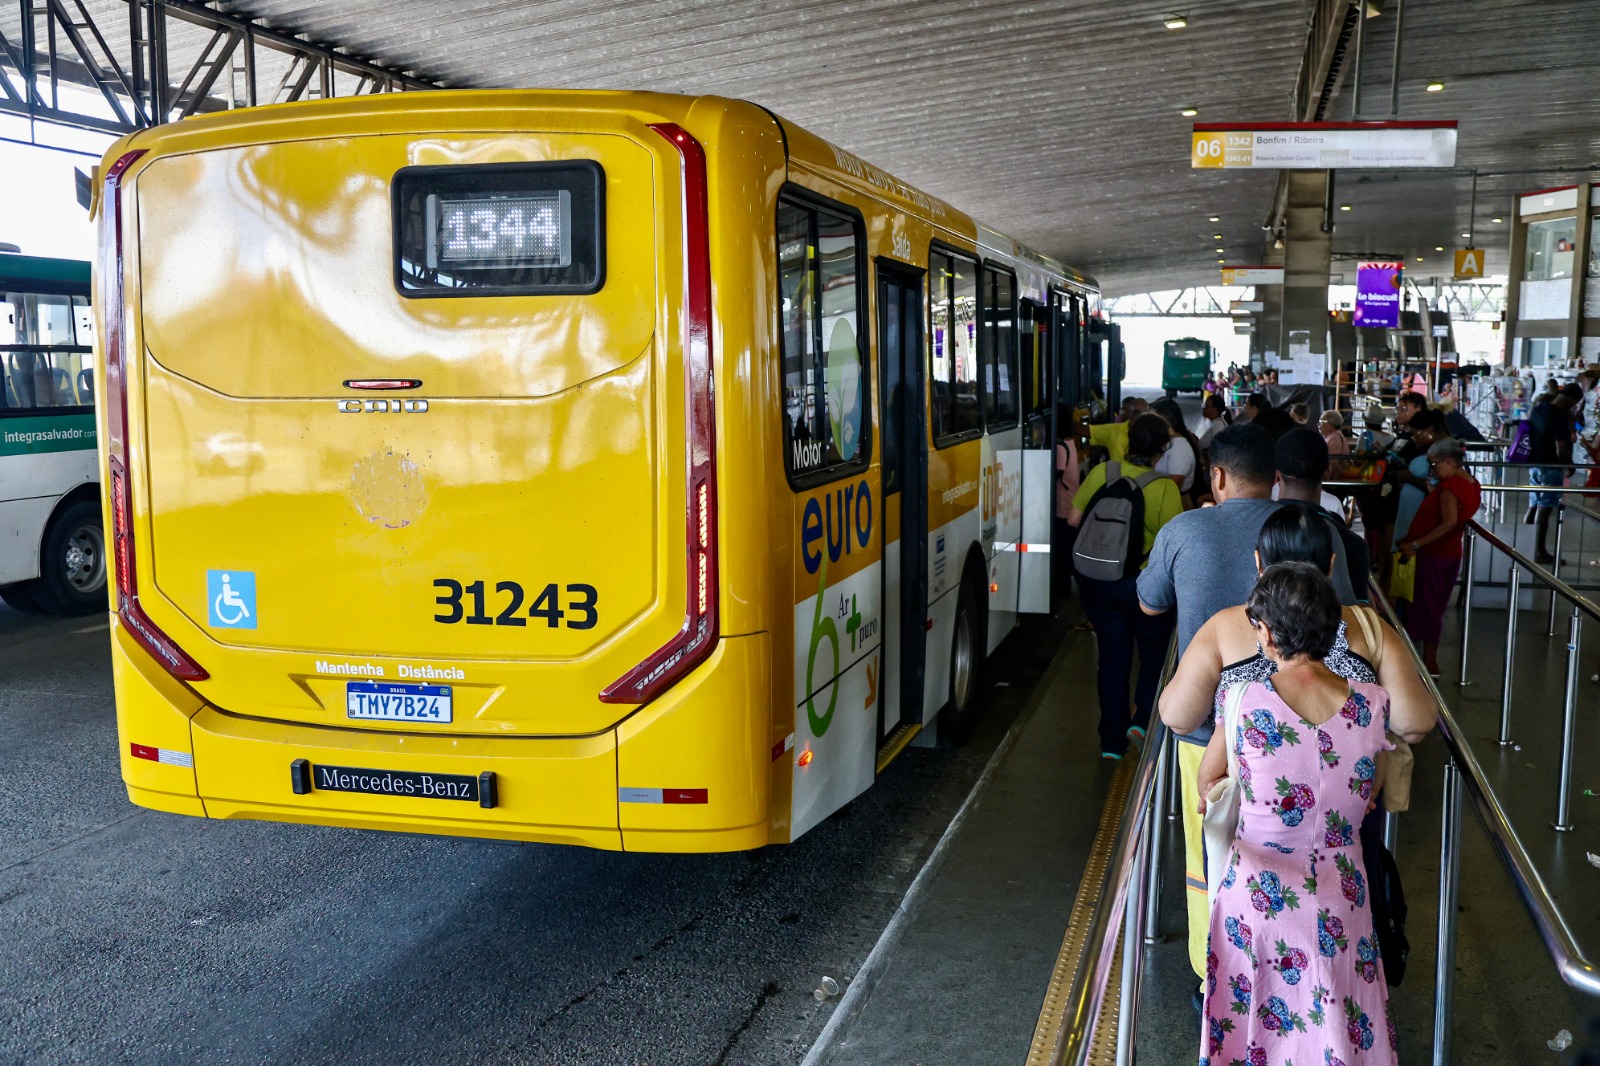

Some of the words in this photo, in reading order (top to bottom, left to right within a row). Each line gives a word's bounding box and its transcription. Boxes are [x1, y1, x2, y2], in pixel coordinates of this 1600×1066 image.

[1197, 140, 1220, 157] 06
[1228, 137, 1251, 146] 1342
[1294, 136, 1324, 144] Ribeira
[448, 208, 557, 249] 1344
[892, 229, 910, 260] Saída
[1460, 253, 1479, 273] A
[337, 400, 428, 413] CAIO
[793, 439, 822, 470] Motor
[802, 480, 872, 575] euro
[432, 579, 599, 630] 31243
[838, 593, 850, 619] Ar
[859, 616, 878, 649] puro
[806, 535, 840, 738] 6
[315, 660, 384, 677] Mantenha
[398, 664, 465, 680] Distância
[356, 694, 440, 718] TMY7B24
[321, 768, 471, 798] Mercedes-Benz
